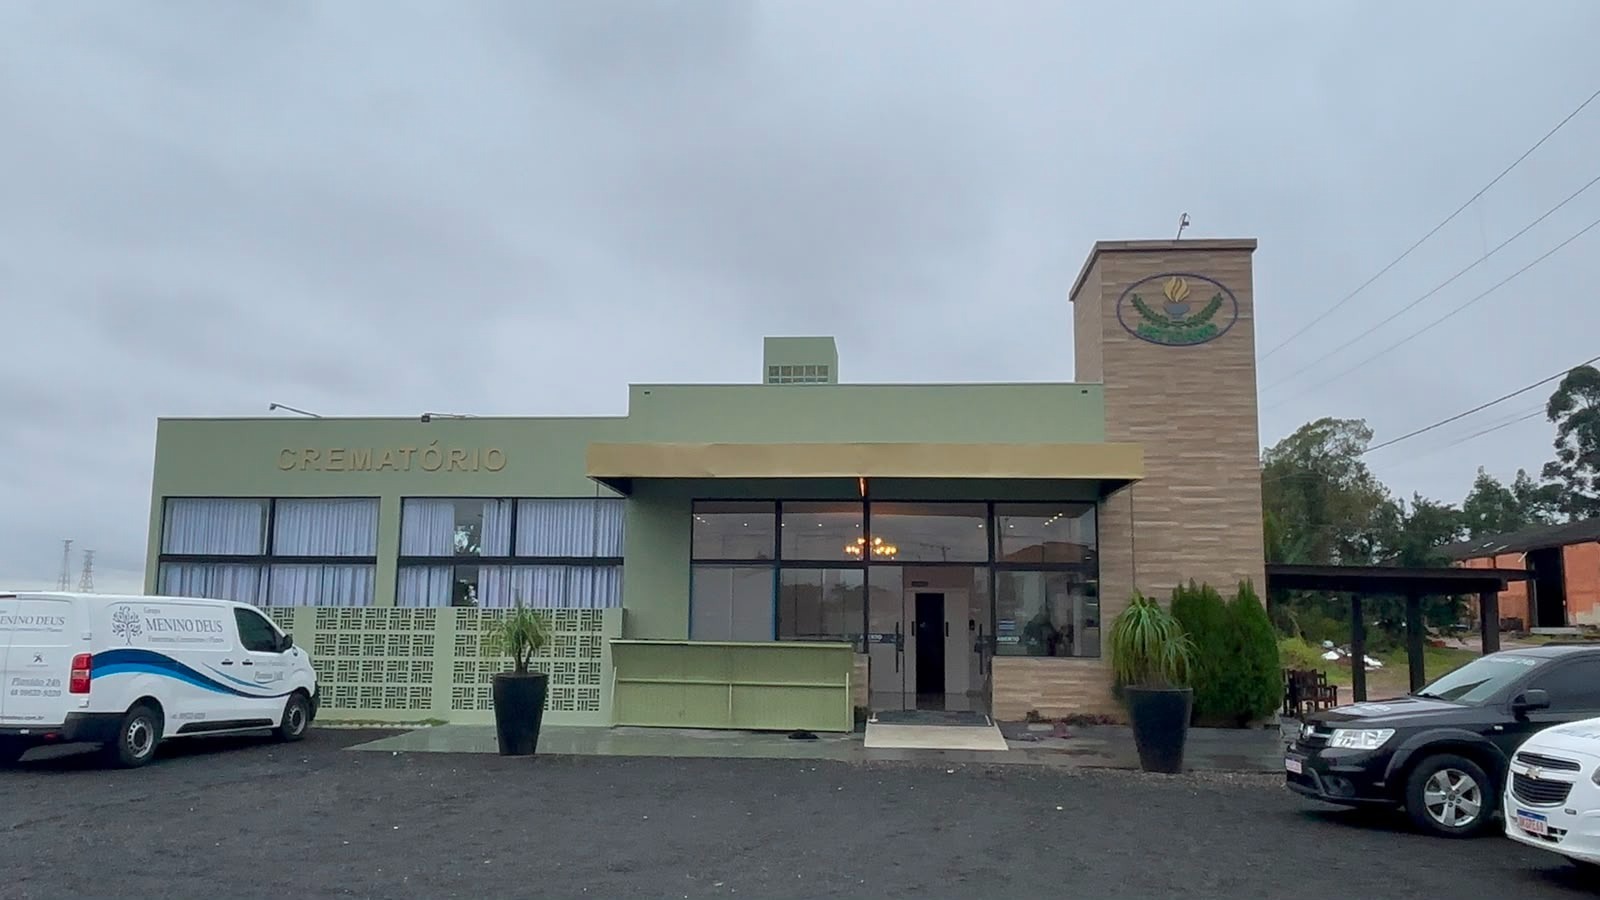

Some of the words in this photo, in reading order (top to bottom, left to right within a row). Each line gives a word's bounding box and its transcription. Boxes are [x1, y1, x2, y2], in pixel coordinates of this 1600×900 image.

[278, 440, 507, 472] CREMATÓRIO
[0, 615, 34, 625] ENINO
[35, 615, 65, 626] DEUS
[145, 617, 194, 632] MENINO
[194, 619, 224, 633] DEUS
